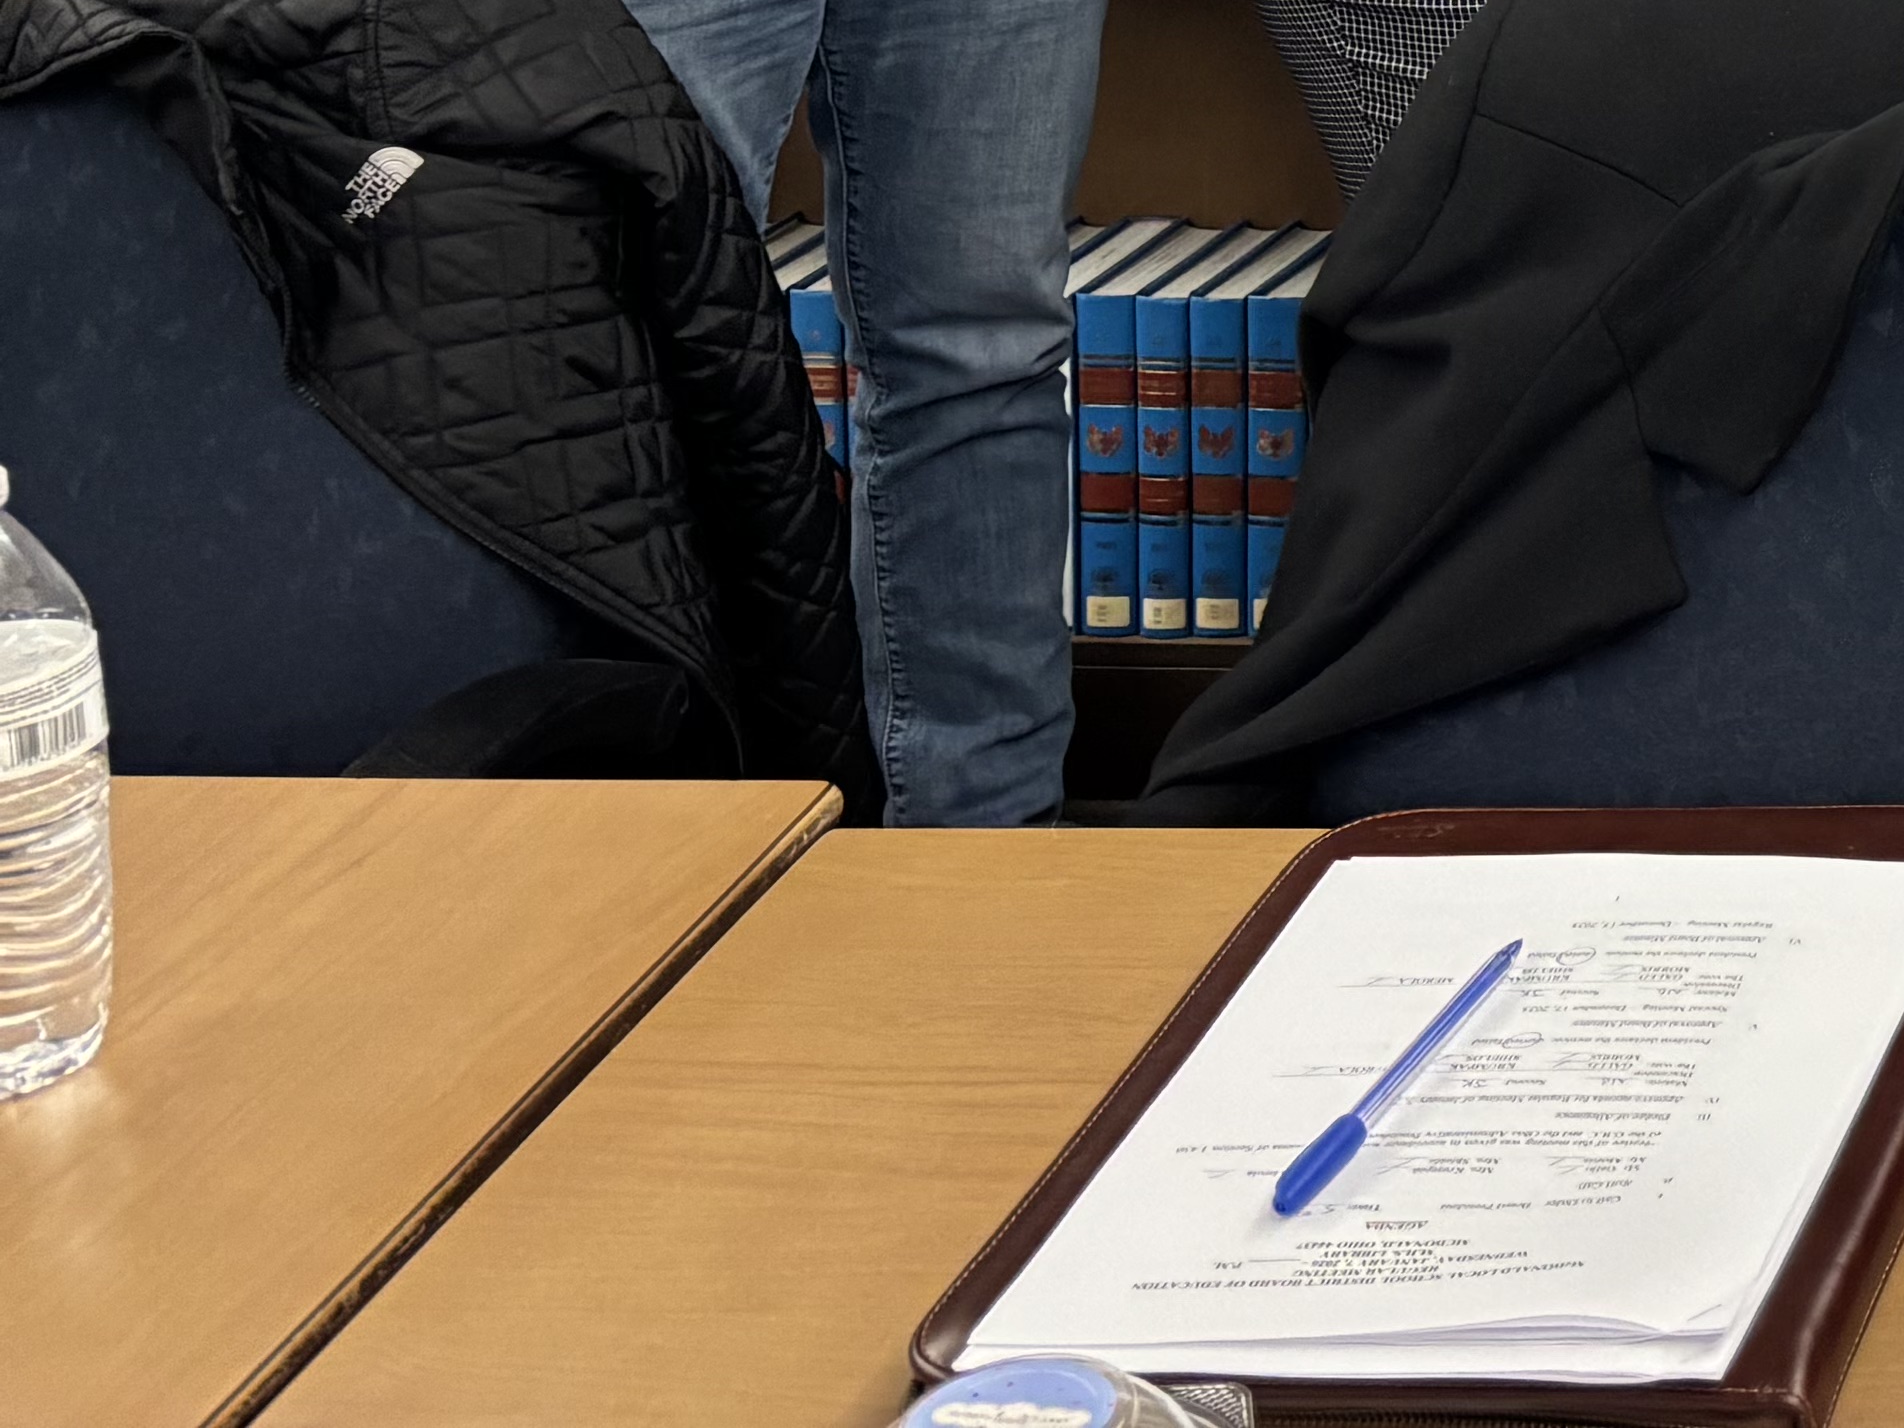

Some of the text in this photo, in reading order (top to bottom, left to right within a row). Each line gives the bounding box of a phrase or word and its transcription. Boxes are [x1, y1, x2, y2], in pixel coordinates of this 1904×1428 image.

[1365, 1221, 1428, 1232] AGENDA
[1337, 1241, 1376, 1249] OHIO
[1320, 1250, 1385, 1259] LIBRARY
[1292, 1268, 1363, 1278] MEETING
[1131, 1273, 1443, 1291] SCHOOL DISTRICT BOARD OF EDUCATION
